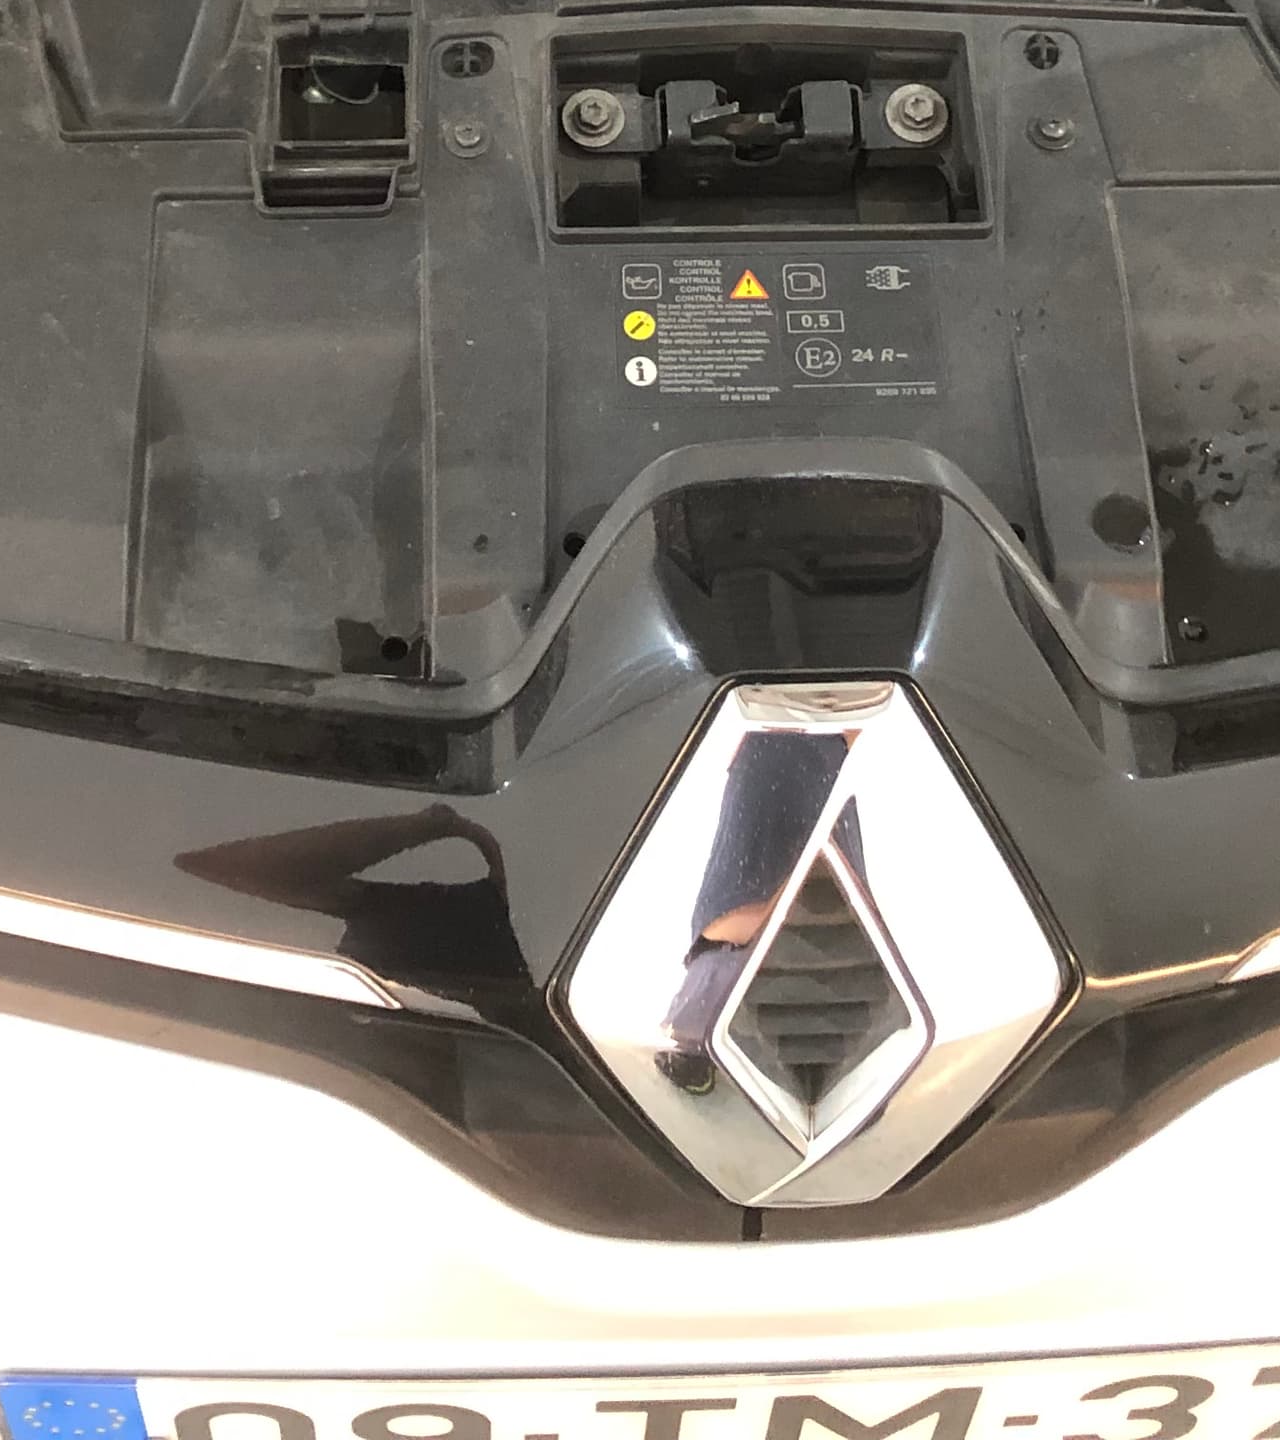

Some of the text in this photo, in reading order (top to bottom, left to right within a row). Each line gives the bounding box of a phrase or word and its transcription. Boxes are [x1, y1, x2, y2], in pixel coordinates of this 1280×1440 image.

[801, 313, 830, 329] 0,5
[803, 347, 837, 370] E2
[851, 348, 874, 363] 24
